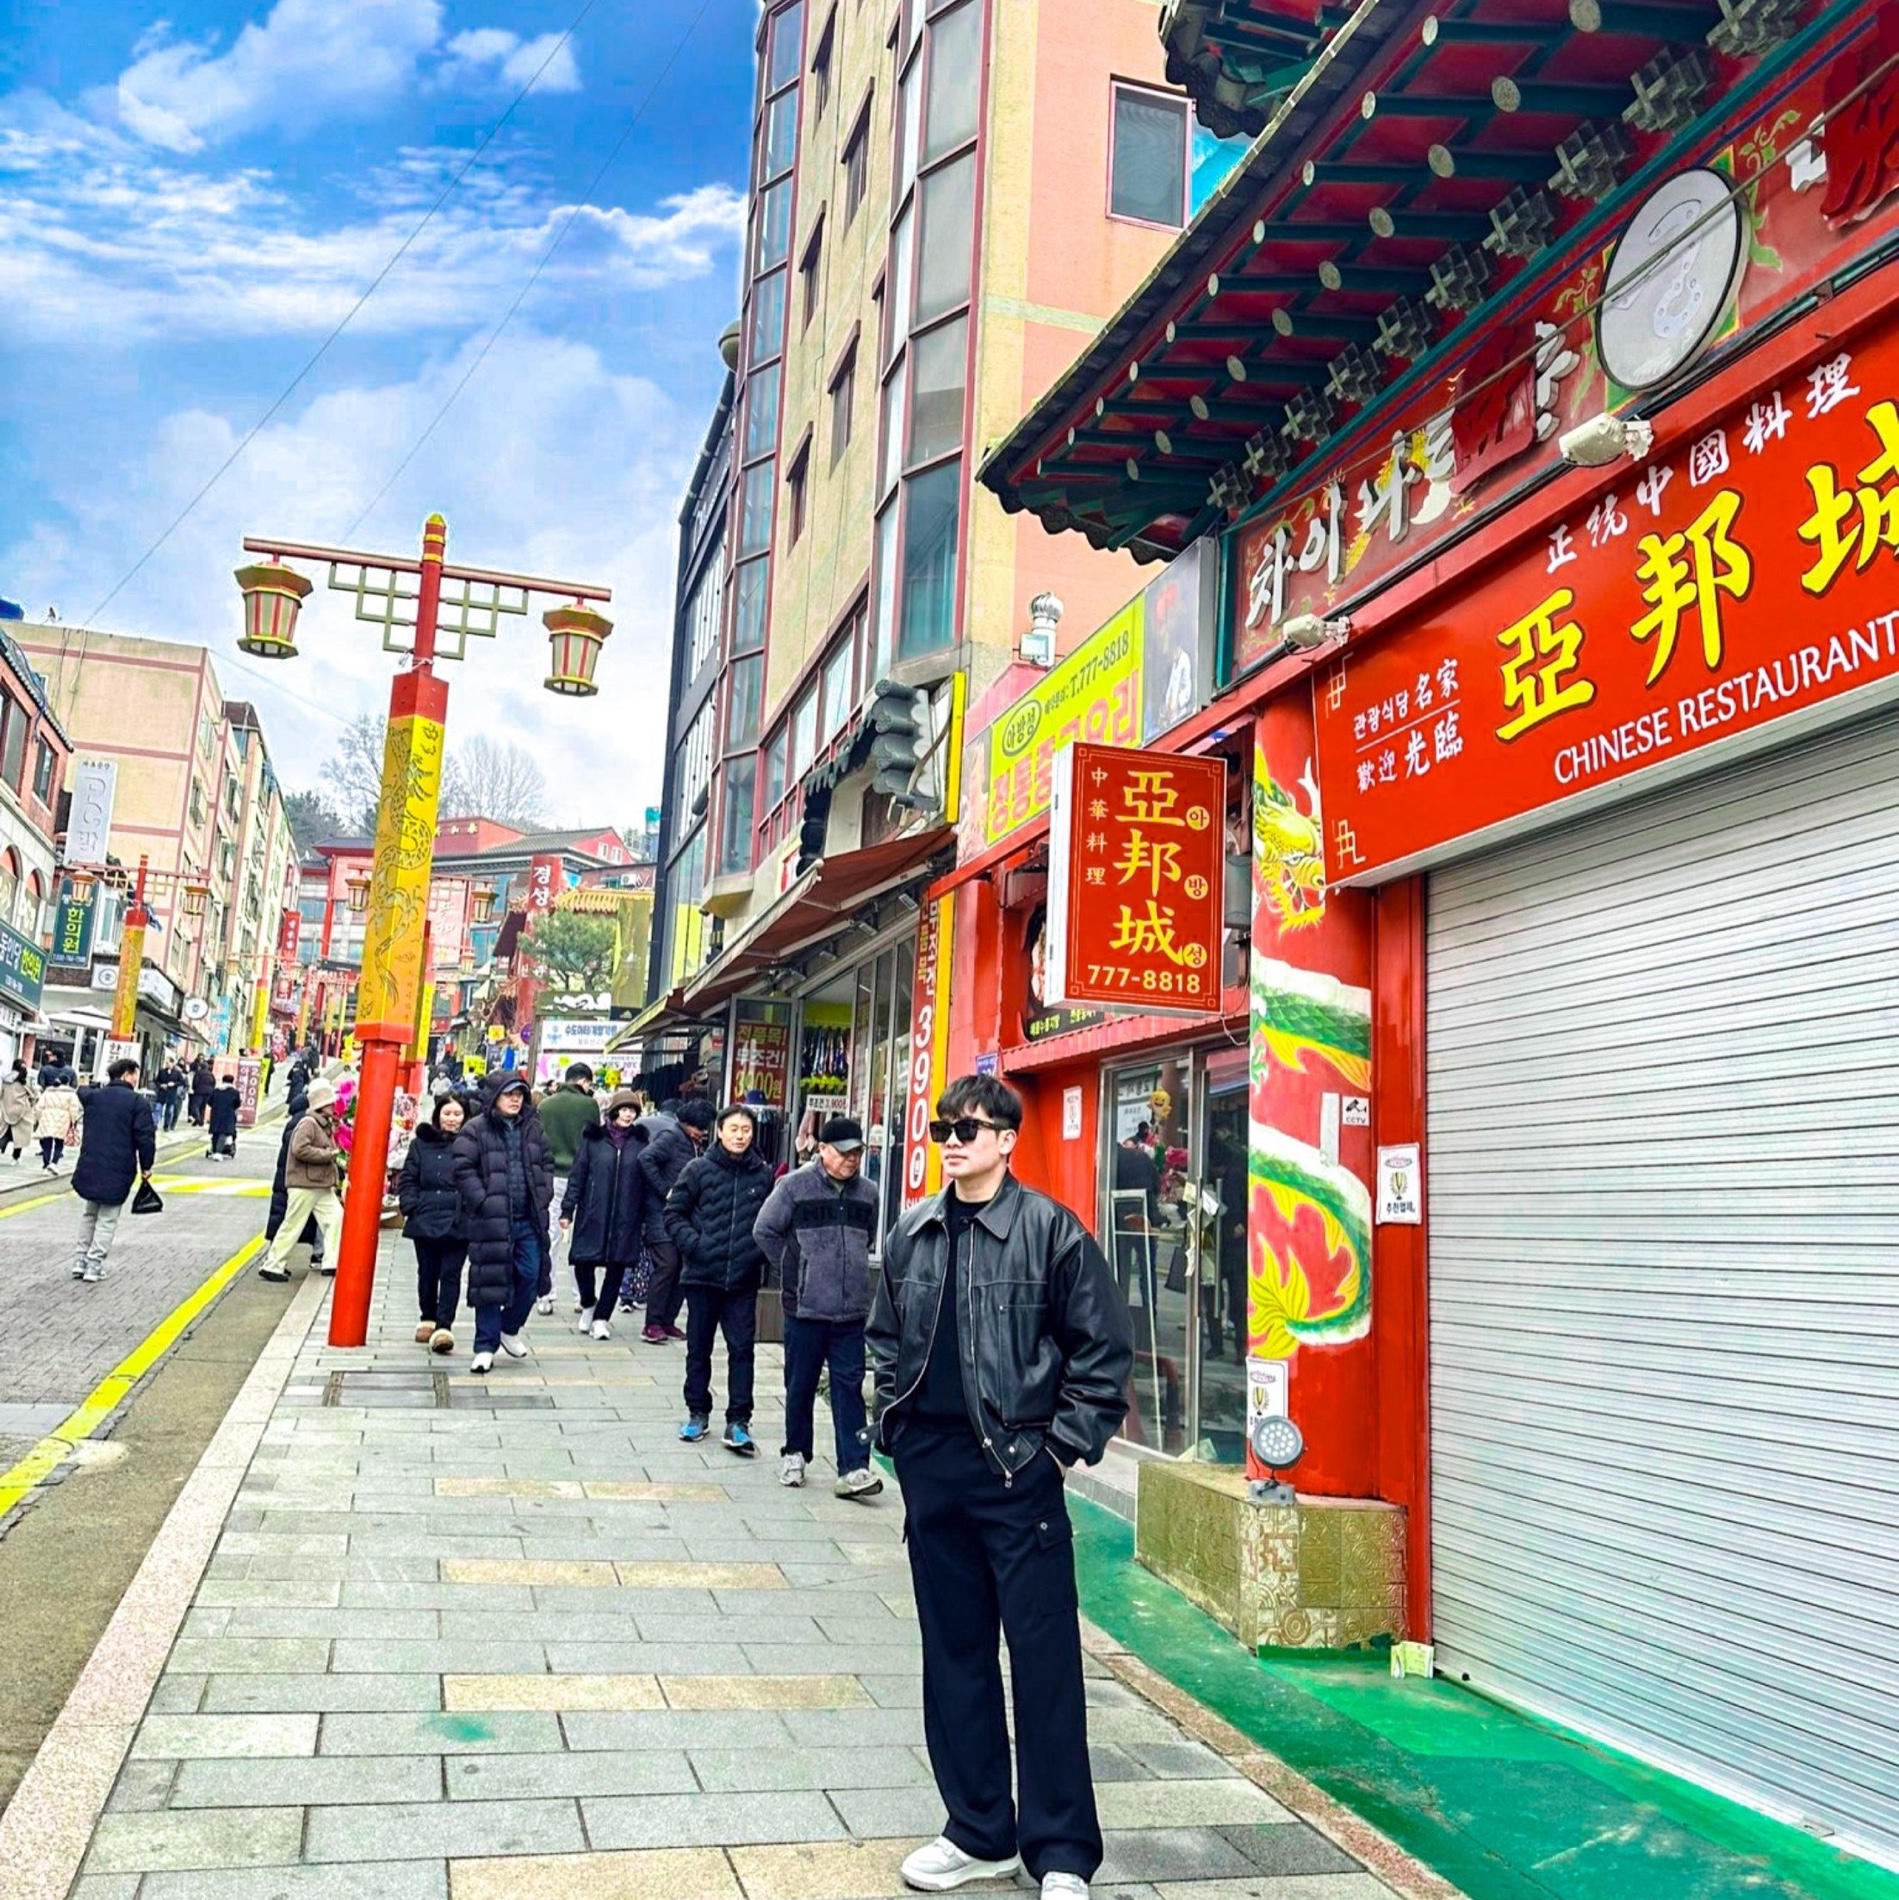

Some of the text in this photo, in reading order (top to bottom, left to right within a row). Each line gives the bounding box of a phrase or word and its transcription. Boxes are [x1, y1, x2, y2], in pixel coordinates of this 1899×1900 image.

[1353, 659, 1459, 740] 관광식당 名家
[1554, 610, 1899, 784] CHINESE RESTAURANT
[1085, 767, 1109, 886] 中華料理
[1110, 770, 1186, 966] 亞邦城
[62, 905, 86, 955] 한의원
[1087, 965, 1201, 994] 777-8818
[247, 1067, 259, 1106] 2000
[908, 1004, 933, 1191] 3900
[1345, 1116, 1367, 1124] CCTV
